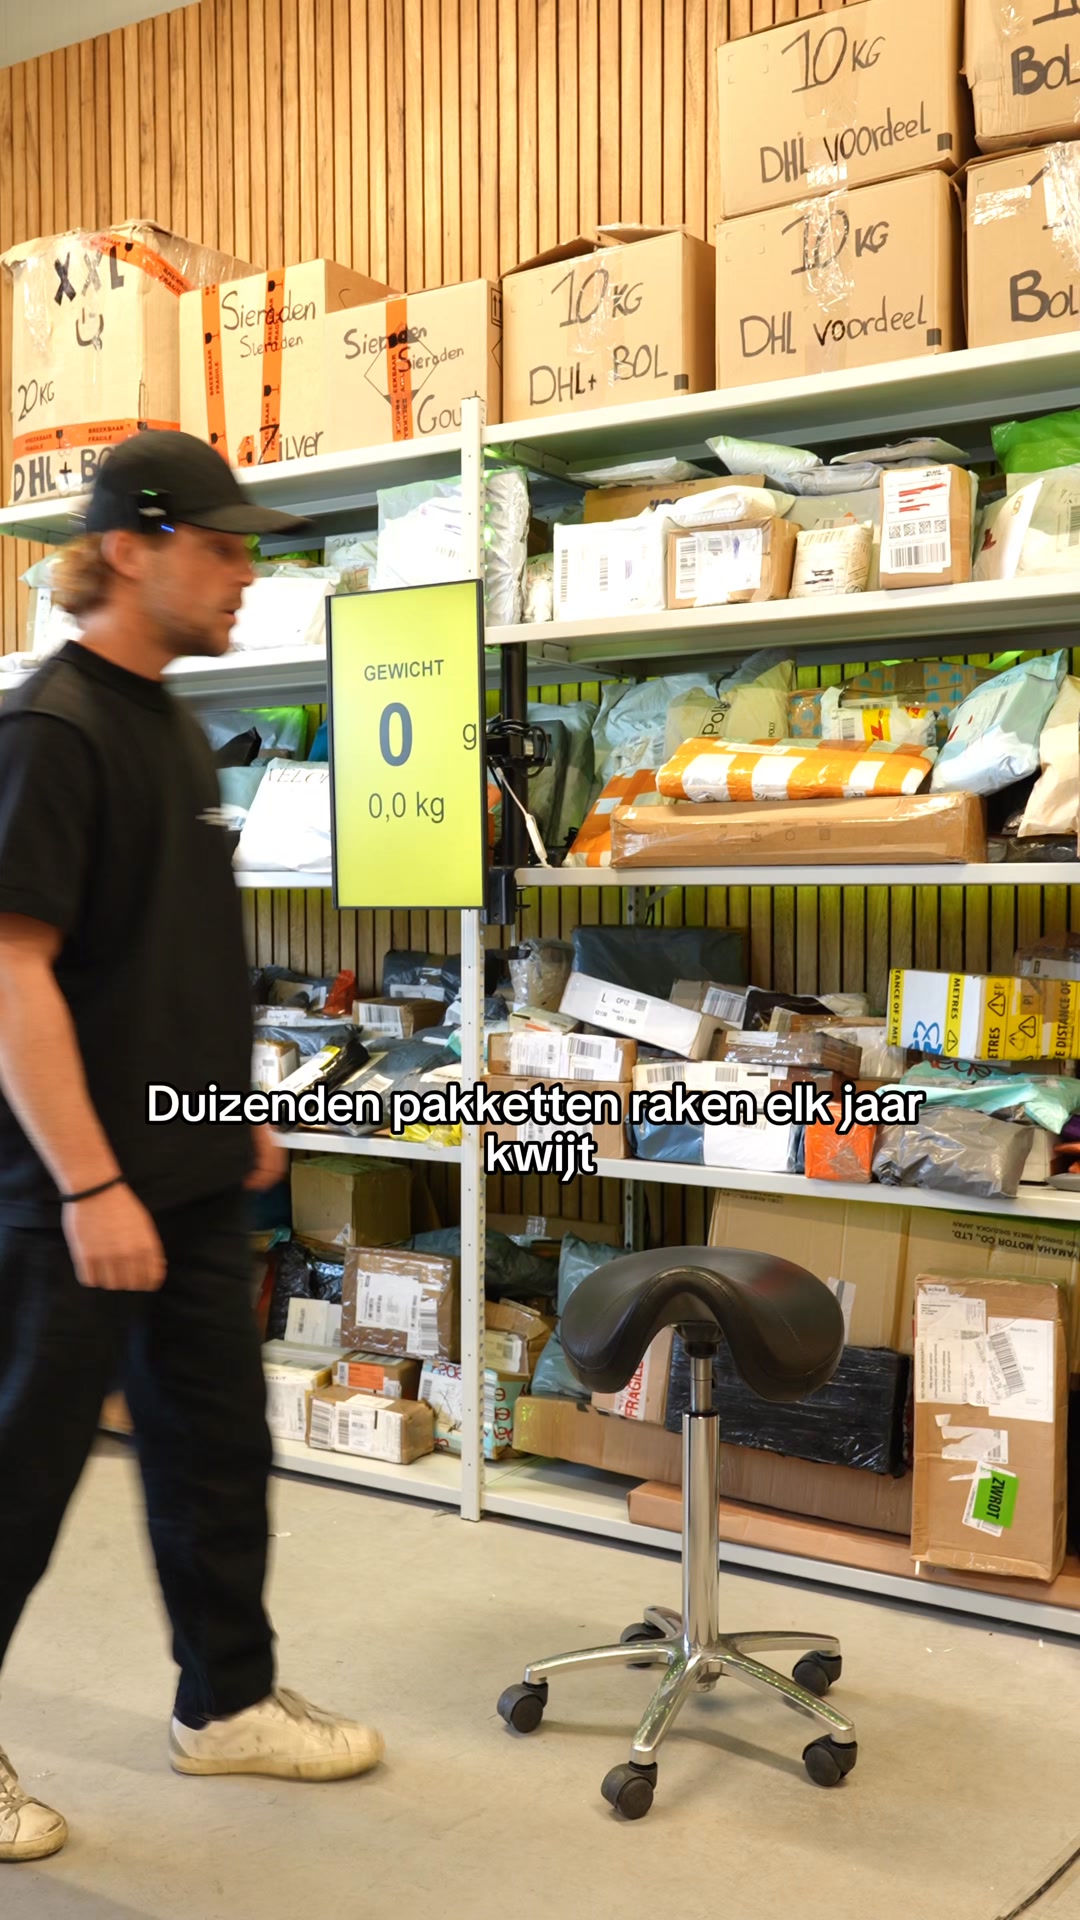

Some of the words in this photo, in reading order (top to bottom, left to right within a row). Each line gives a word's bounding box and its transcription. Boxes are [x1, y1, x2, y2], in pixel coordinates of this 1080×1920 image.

[760, 136, 808, 183] DHL
[54, 246, 124, 305] XXL
[222, 290, 315, 330] Sieraden
[240, 335, 303, 358] Sieraden
[740, 311, 796, 358] DHL
[398, 346, 464, 373] Sieraden
[613, 344, 668, 381] BOL
[364, 659, 445, 681] GEWICHT
[379, 702, 413, 767] 0
[462, 723, 477, 750] g
[369, 791, 406, 822] 0,0
[416, 791, 445, 824] kg
[950, 977, 961, 1020] METRES
[1056, 1001, 1070, 1048] DISTANCE
[952, 1230, 973, 1240] LTD.
[998, 1238, 1034, 1251] MOTOR
[1037, 1245, 1080, 1260] YAMAHA
[986, 1476, 1006, 1520] ZWROT
